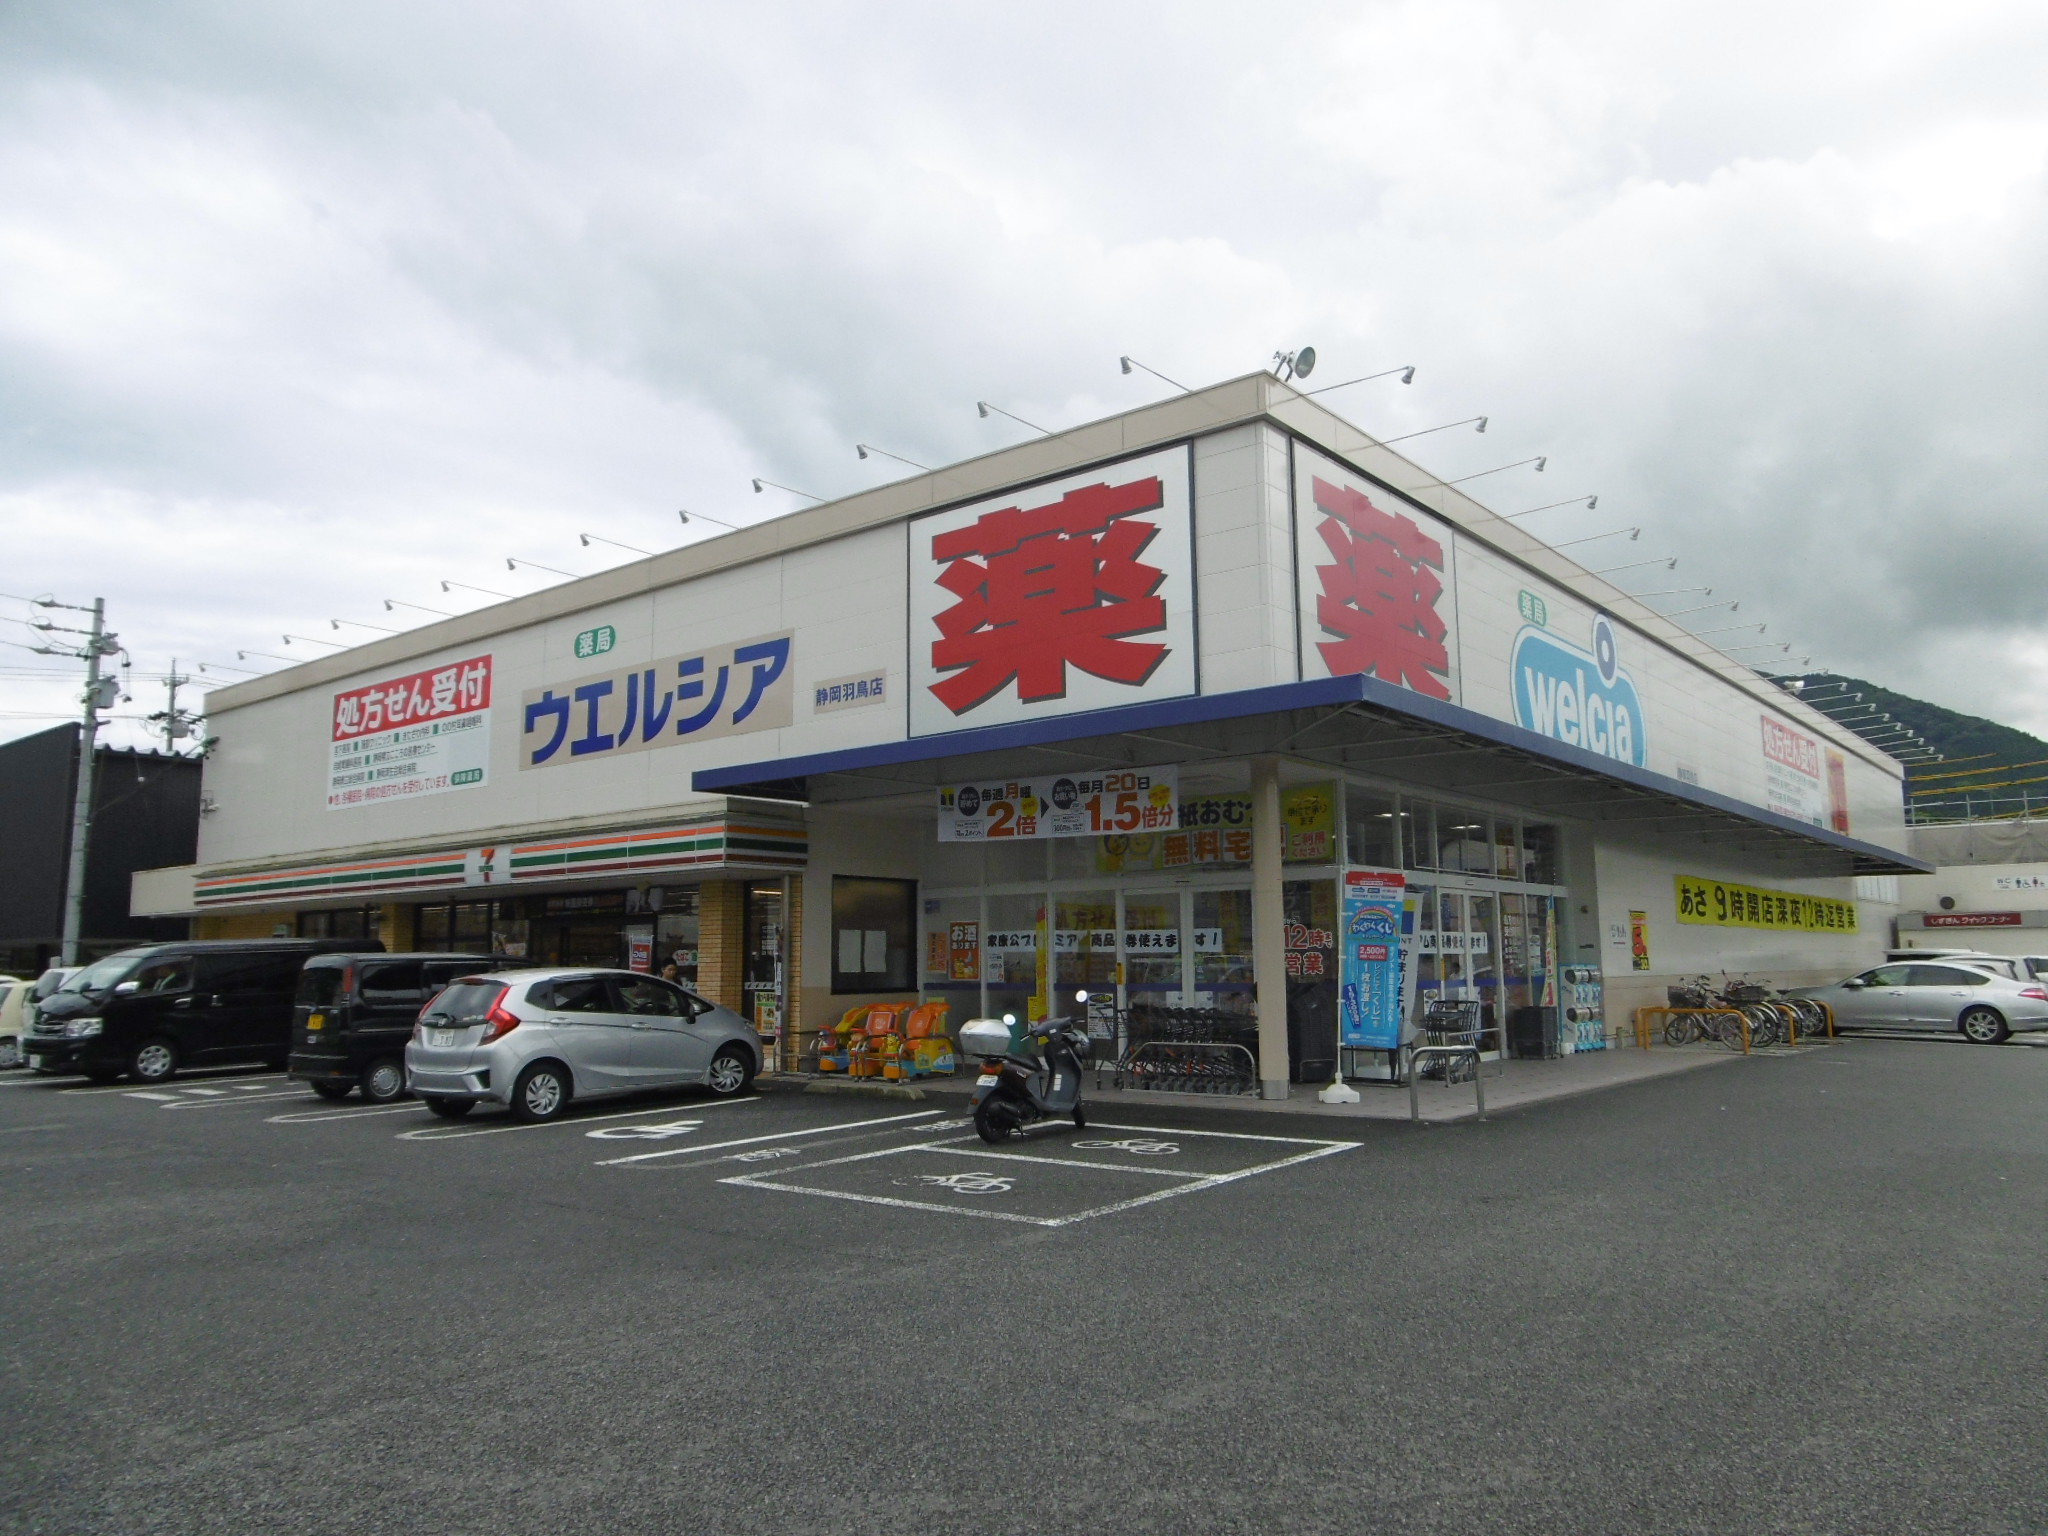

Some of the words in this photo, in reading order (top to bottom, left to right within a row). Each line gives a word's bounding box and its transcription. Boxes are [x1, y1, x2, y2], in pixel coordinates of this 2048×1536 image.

[927, 475, 1173, 717] 薬
[1312, 475, 1451, 701] 薬
[1521, 590, 1546, 625] 薬局
[578, 628, 612, 657] 薬局
[336, 661, 486, 738] 処方せん受付
[524, 636, 791, 766] ウエルシア
[815, 677, 884, 706] 静岡羽鳥店
[1077, 772, 1151, 795] 毎月20日
[986, 800, 1037, 838] 2倍
[1291, 830, 1327, 847] ご利用
[1291, 845, 1327, 859] ください
[951, 923, 978, 942] お酒
[951, 941, 978, 951] あります
[1284, 951, 1324, 976] 営業
